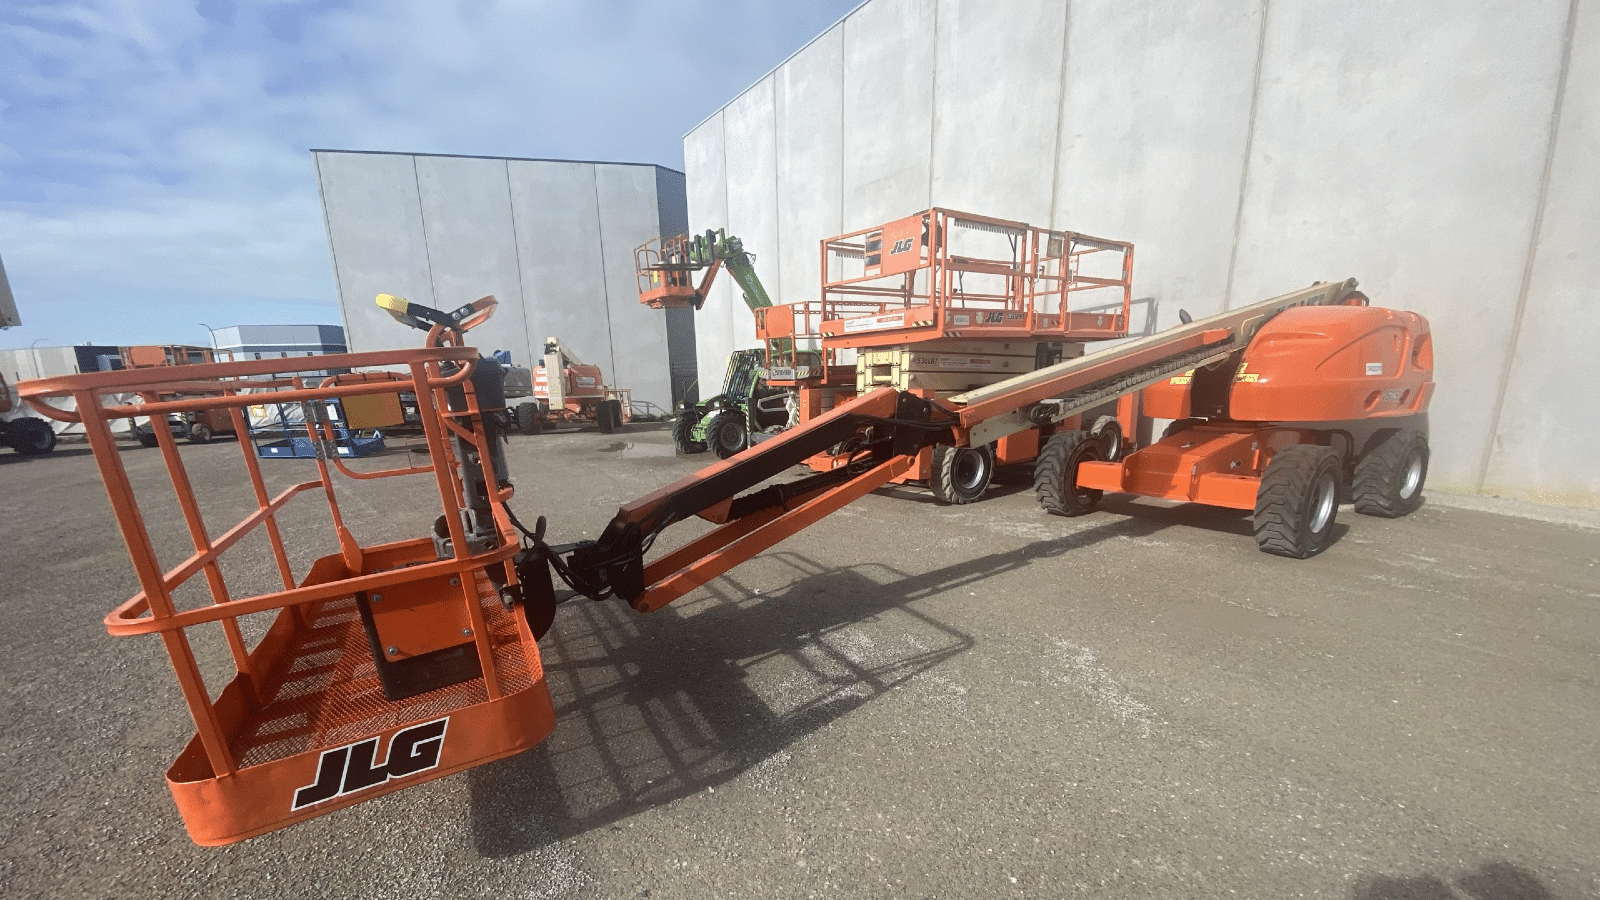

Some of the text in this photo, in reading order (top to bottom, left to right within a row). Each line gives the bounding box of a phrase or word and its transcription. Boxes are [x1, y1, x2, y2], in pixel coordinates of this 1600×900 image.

[889, 237, 914, 255] JLG
[984, 311, 1004, 325] JLG
[291, 716, 449, 812] JLG
